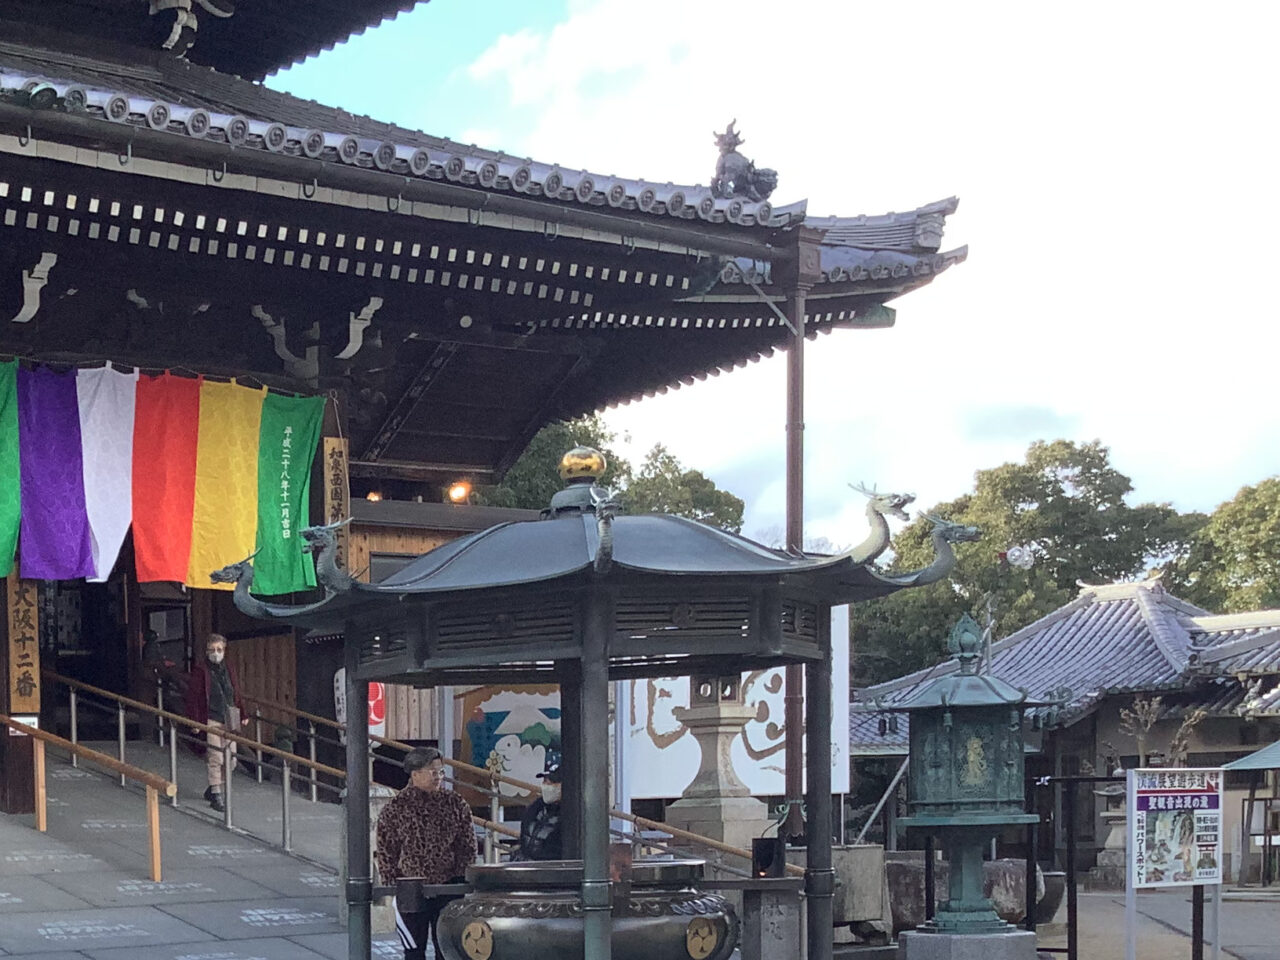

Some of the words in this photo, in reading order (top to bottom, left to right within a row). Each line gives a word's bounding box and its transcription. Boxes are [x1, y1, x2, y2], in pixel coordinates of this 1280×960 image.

[280, 426, 293, 539] 平成二十八年十一月吉日
[13, 587, 37, 698] 大阪十二番
